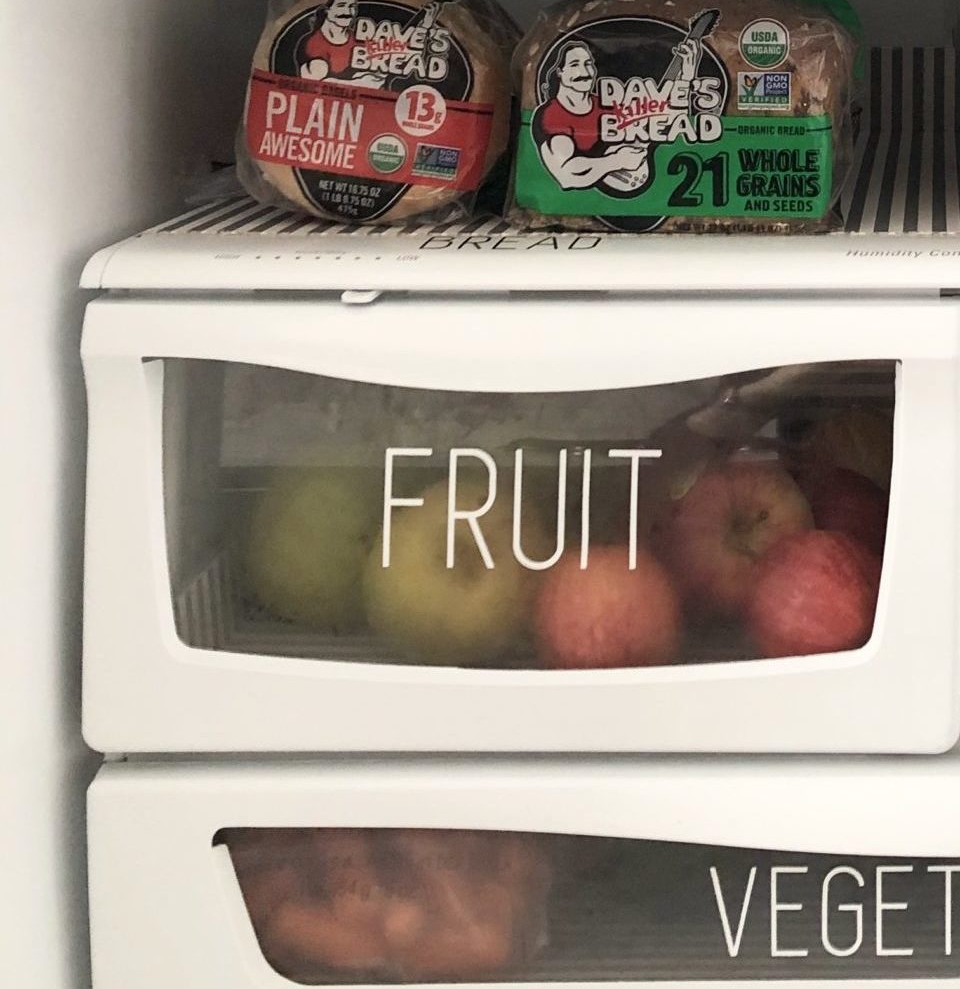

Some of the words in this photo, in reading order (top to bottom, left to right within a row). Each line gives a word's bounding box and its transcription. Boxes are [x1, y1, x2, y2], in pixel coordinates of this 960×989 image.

[354, 18, 451, 53] DAVE'S
[751, 31, 778, 42] USDA
[351, 46, 447, 80] BREAD
[747, 46, 781, 54] ORGANIC
[601, 76, 721, 110] DAVE'S
[266, 91, 364, 143] PLAIN
[612, 97, 669, 124] Killer
[601, 114, 722, 143] BREAD
[737, 125, 775, 135] ORGANIC
[778, 126, 806, 136] BREAD
[259, 132, 357, 169] AWESOME
[377, 142, 399, 153] USDA
[737, 148, 821, 173] WHOLE
[667, 151, 729, 208] 21
[737, 174, 821, 198] GRAINS
[744, 200, 770, 212] AND
[773, 200, 813, 212] SEEDS
[419, 236, 602, 250] BREAD
[846, 249, 922, 259] Humidity
[381, 447, 663, 572] FRUIT
